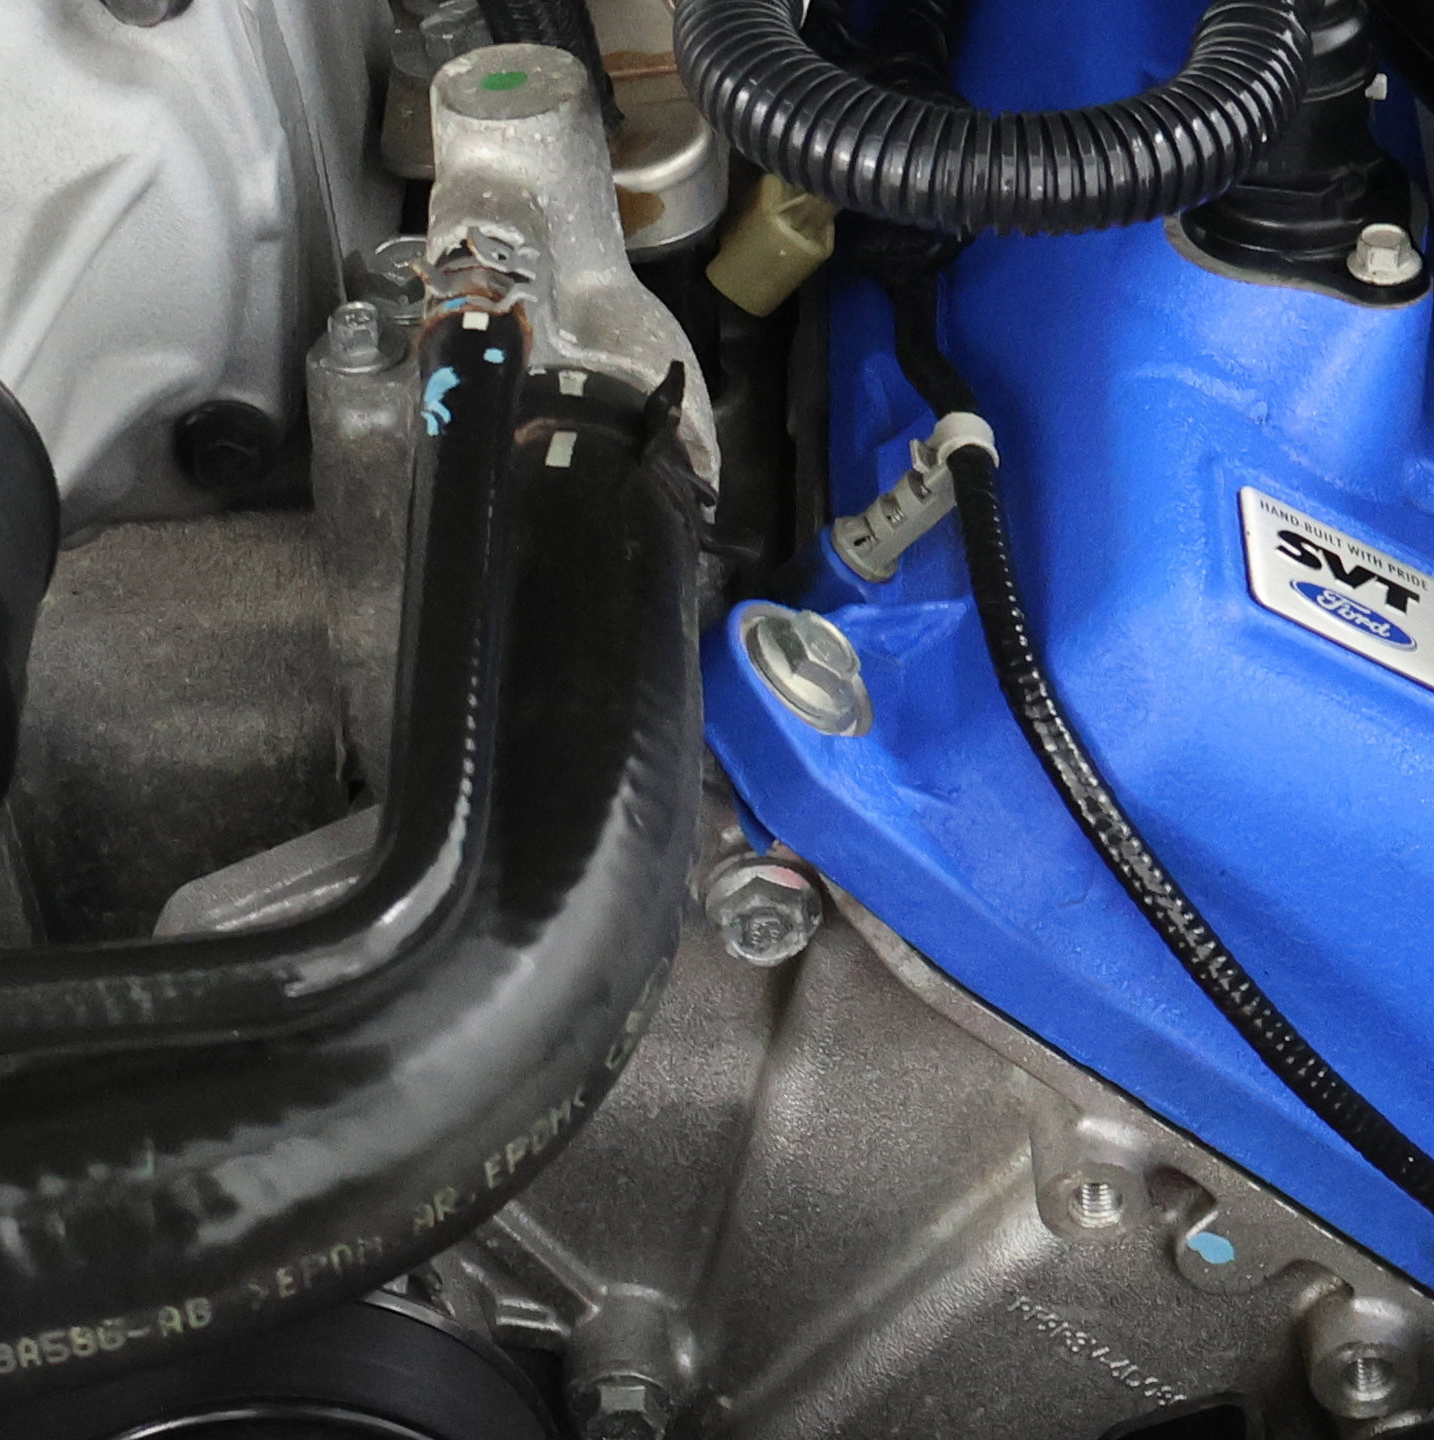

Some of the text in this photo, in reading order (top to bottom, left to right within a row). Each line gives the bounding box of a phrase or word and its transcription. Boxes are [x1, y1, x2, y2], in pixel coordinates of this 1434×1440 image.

[1259, 499, 1429, 591] HAND-BUILT WITH PRIDE
[1275, 529, 1420, 615] SVT
